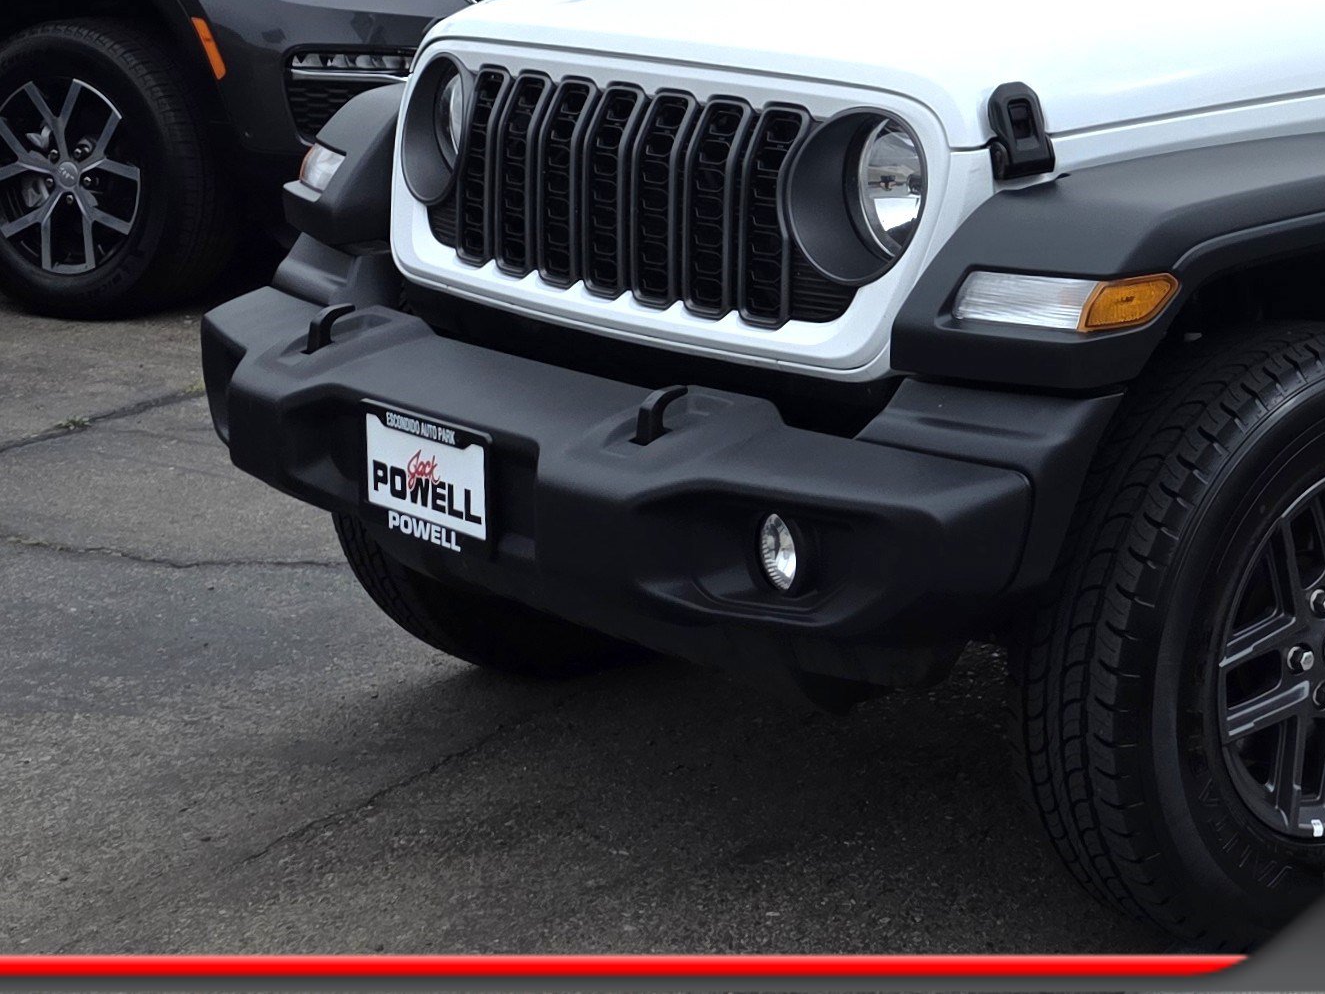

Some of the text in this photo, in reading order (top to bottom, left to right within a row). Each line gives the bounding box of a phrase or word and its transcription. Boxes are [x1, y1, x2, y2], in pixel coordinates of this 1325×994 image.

[421, 422, 437, 439] AUTO
[438, 427, 455, 445] PARK
[407, 449, 441, 491] Jack
[372, 459, 482, 525] POWELL
[387, 510, 462, 553] POWELL
